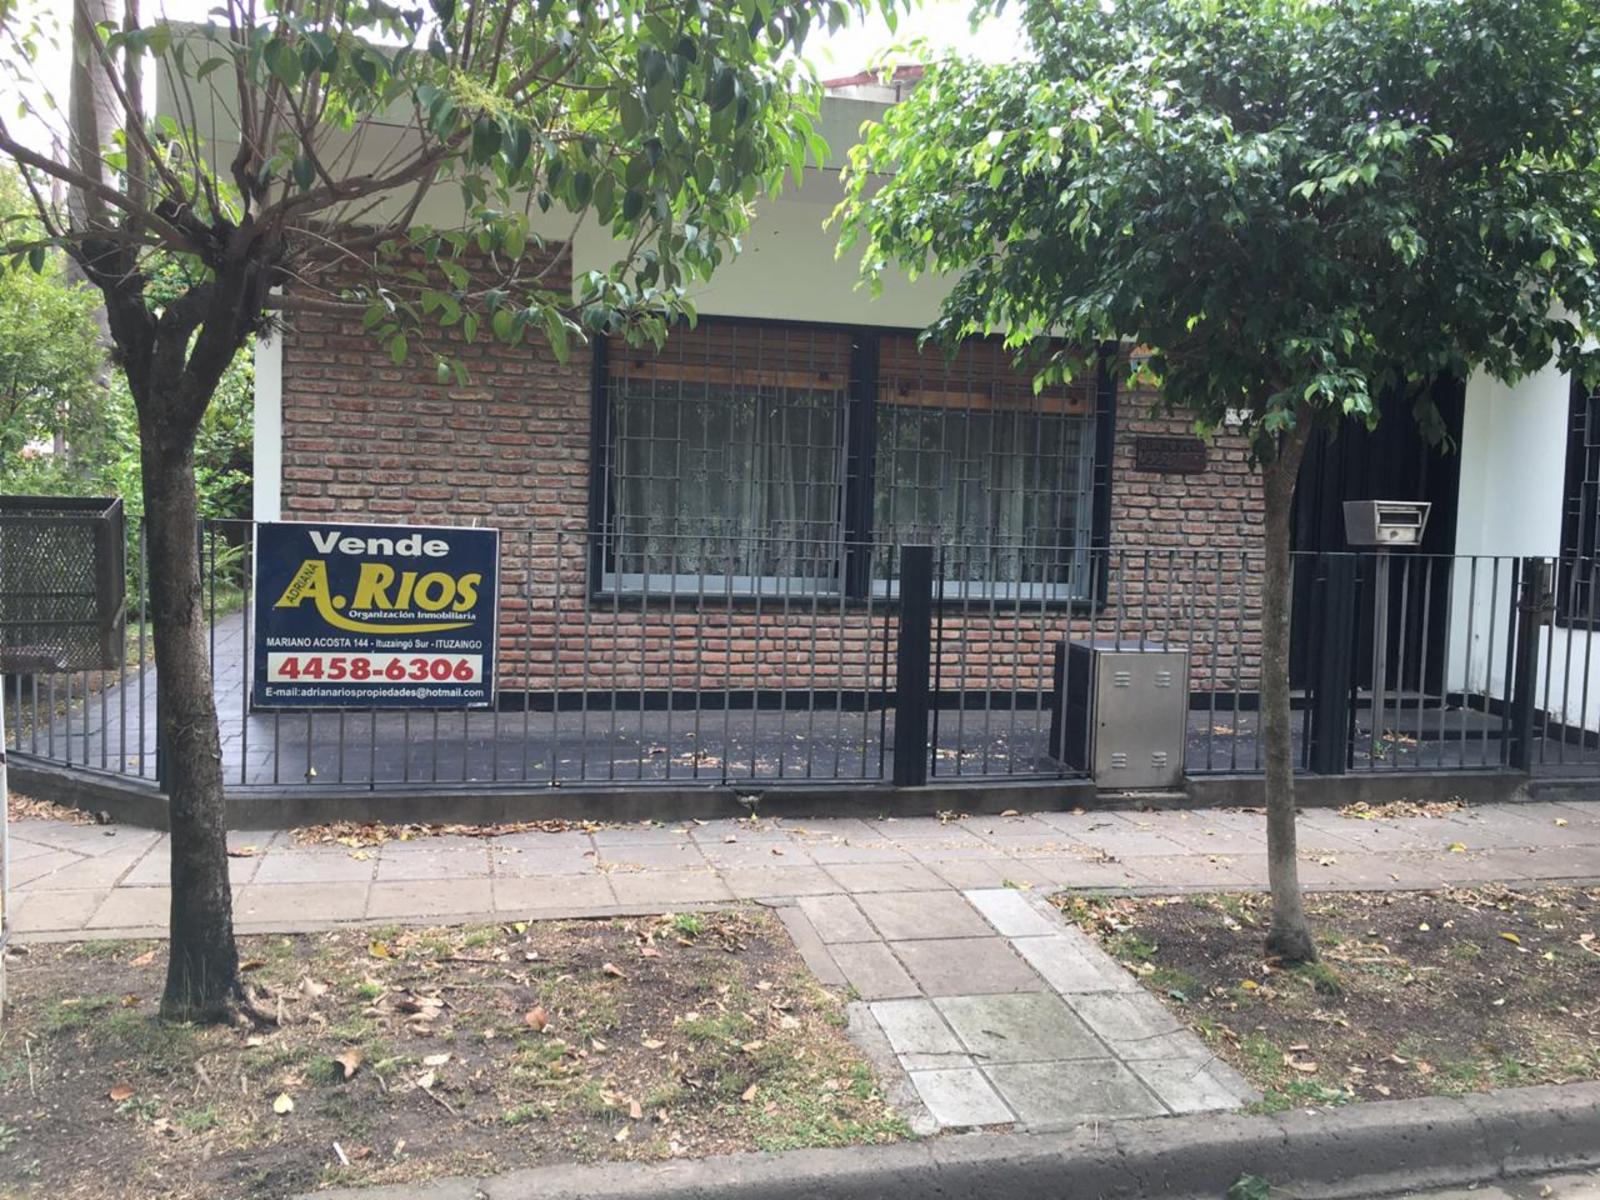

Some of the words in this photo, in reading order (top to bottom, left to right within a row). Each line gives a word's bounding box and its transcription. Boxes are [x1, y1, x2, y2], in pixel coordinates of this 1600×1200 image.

[309, 531, 450, 556] Vende
[285, 563, 319, 603] ADRIANA
[348, 610, 415, 620] Organización
[417, 611, 476, 620] Inmobiliaria
[266, 638, 312, 647] MARIANO
[313, 638, 351, 647] ACOSTA
[354, 638, 369, 647] 144
[375, 638, 413, 650] Ituzaingó
[415, 639, 429, 649] Sur
[435, 640, 482, 649] ITUZAINGO
[278, 657, 475, 681] 4458-6306
